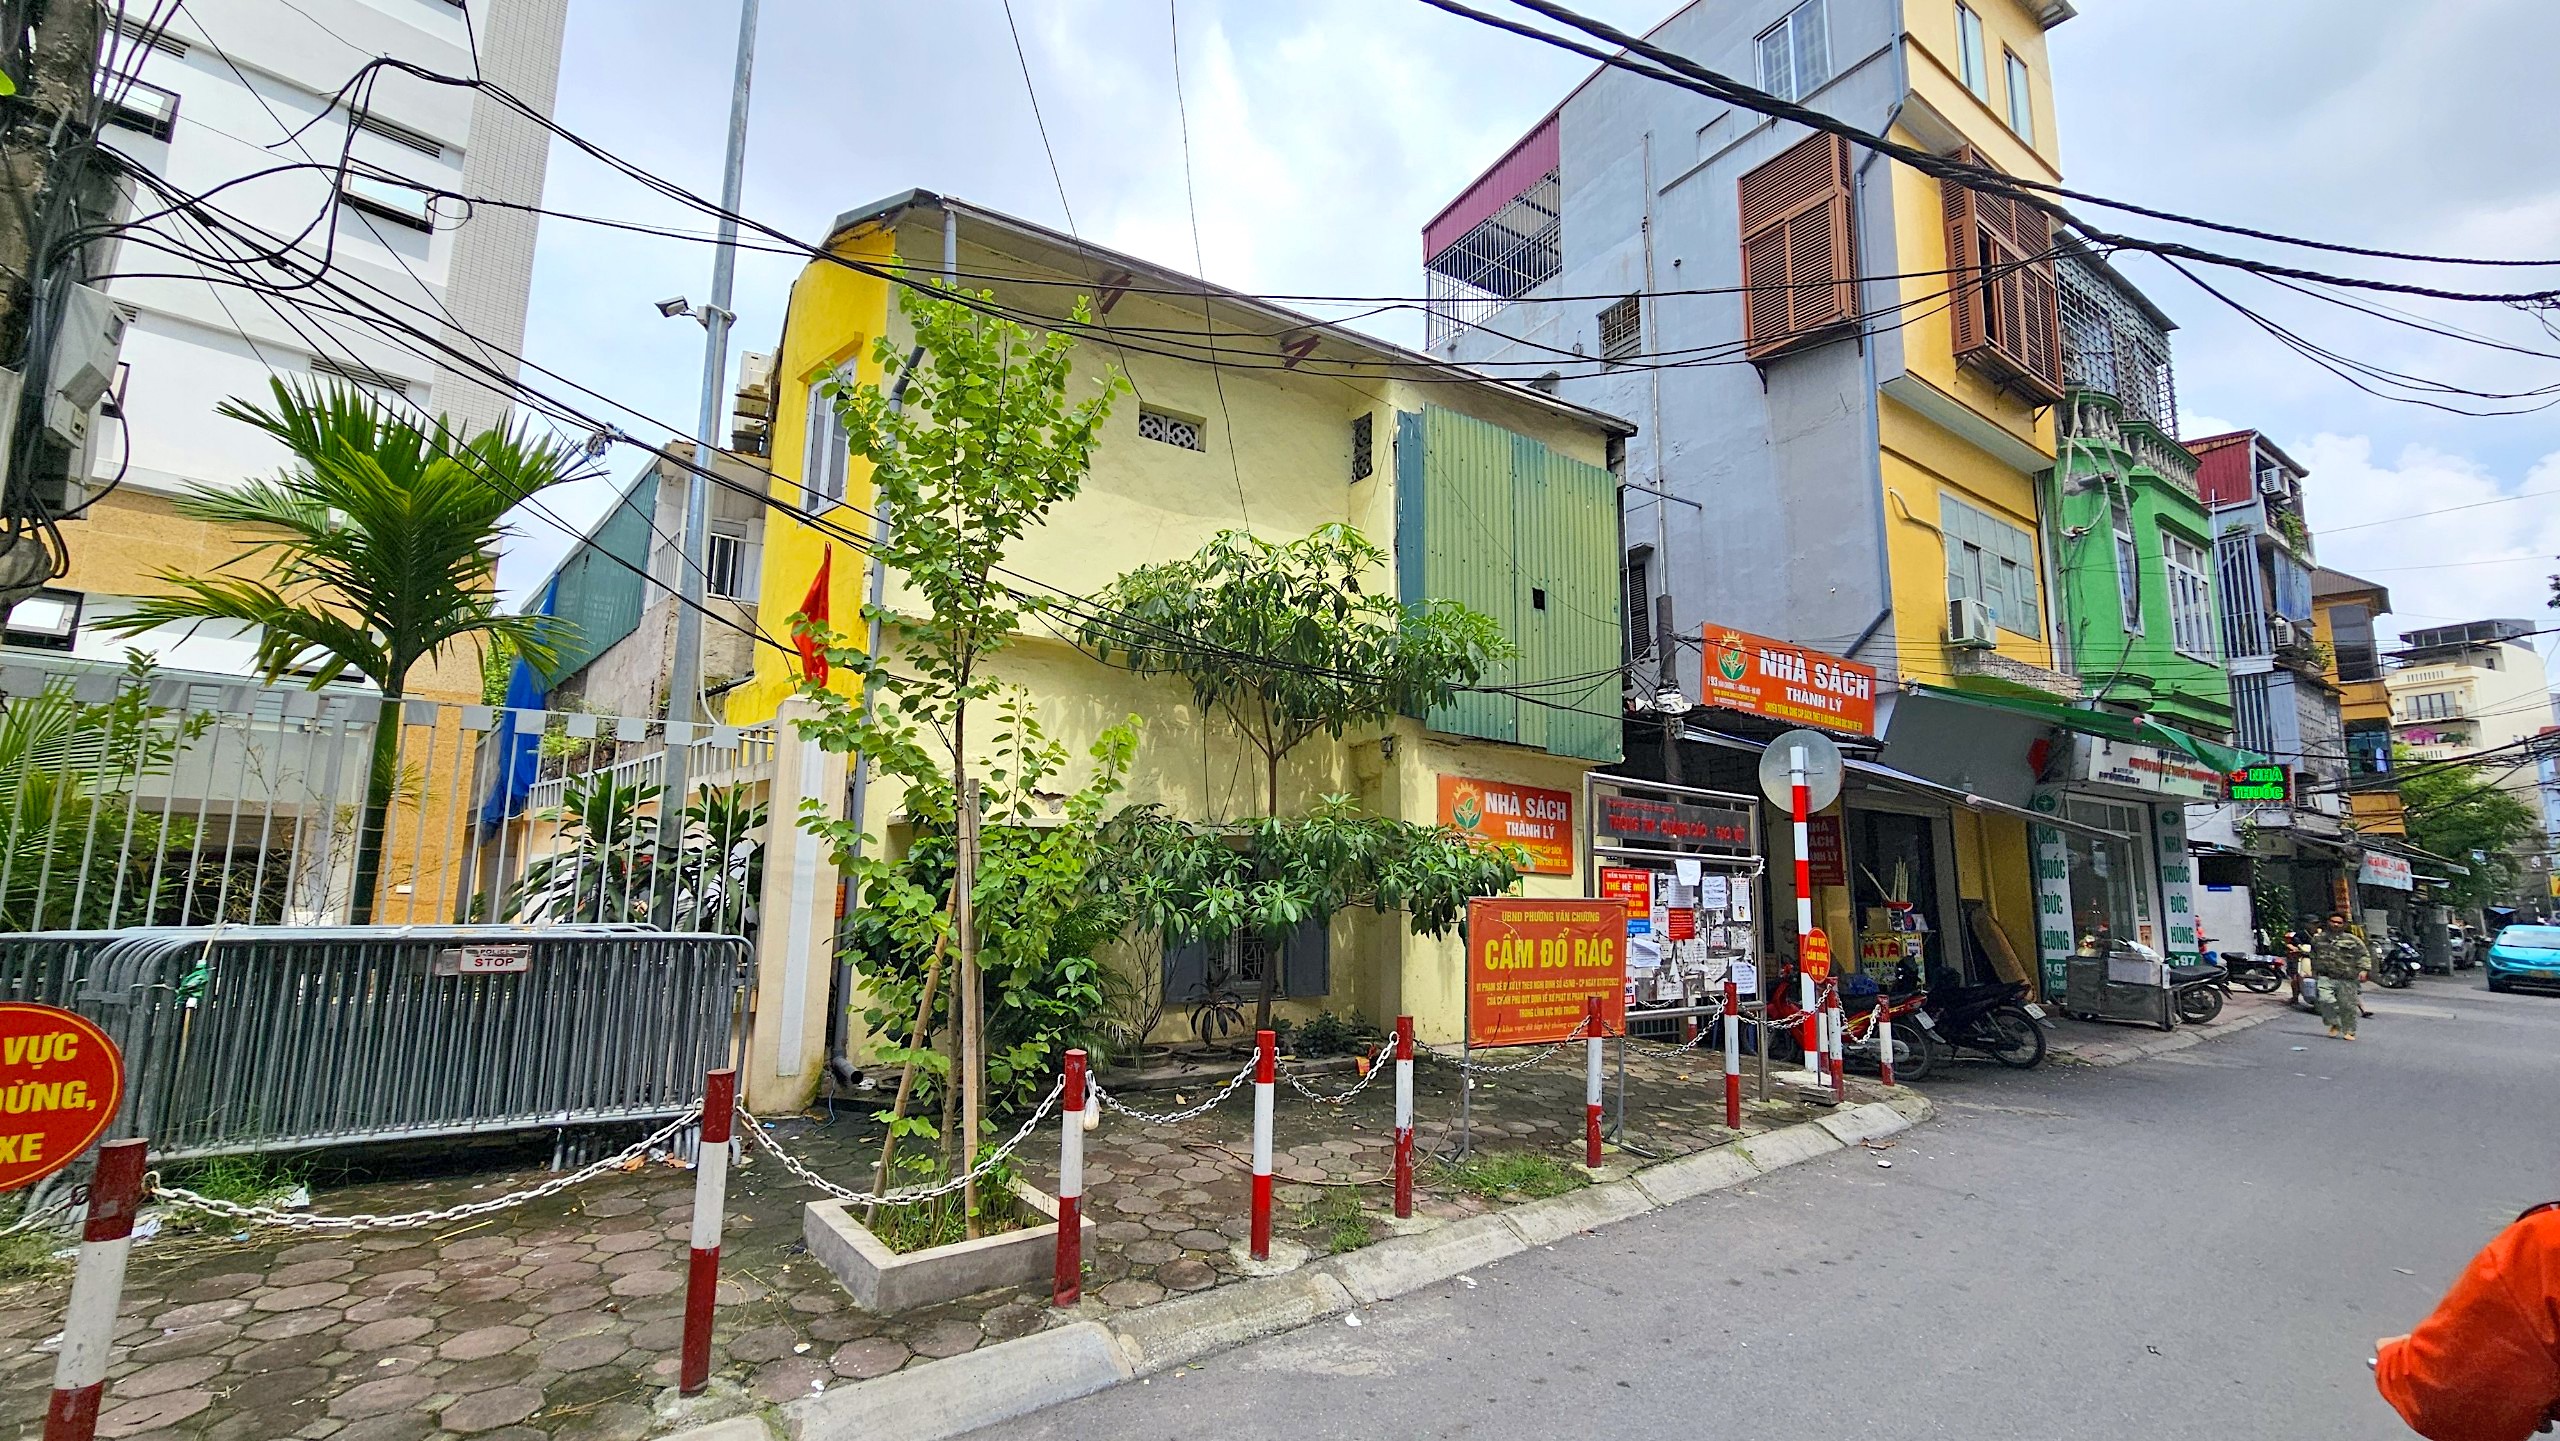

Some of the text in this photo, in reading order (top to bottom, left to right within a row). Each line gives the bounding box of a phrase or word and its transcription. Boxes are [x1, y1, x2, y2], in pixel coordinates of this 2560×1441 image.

[1760, 648, 1869, 701] NHÀ SÁCH
[1786, 687, 1826, 709] THÀNH
[1829, 697, 1843, 713] LÝ
[2250, 766, 2284, 783] NHÀ
[2231, 782, 2284, 800] THUỐC
[1485, 791, 1567, 821] NHÀ SÁCH
[1505, 820, 1555, 839] THÀNH LÝ
[2040, 852, 2066, 880] HUỐC
[2163, 859, 2190, 883] THUỐC
[1605, 880, 1621, 891] THẾ
[1621, 881, 1632, 893] HỆ
[2044, 890, 2063, 914] ĐỨC
[2170, 892, 2188, 914] ĐỨC
[1502, 909, 1600, 922] UBND PHƯỜNG VĂN CHƯƠNG
[2170, 922, 2194, 945] HÙNG
[1485, 927, 1614, 970] CẤM ĐỔ RÁC
[474, 957, 515, 967] STOP
[4, 1031, 79, 1070] VỰC
[0, 1079, 97, 1115] ỪNG,
[0, 1132, 46, 1165] XE
